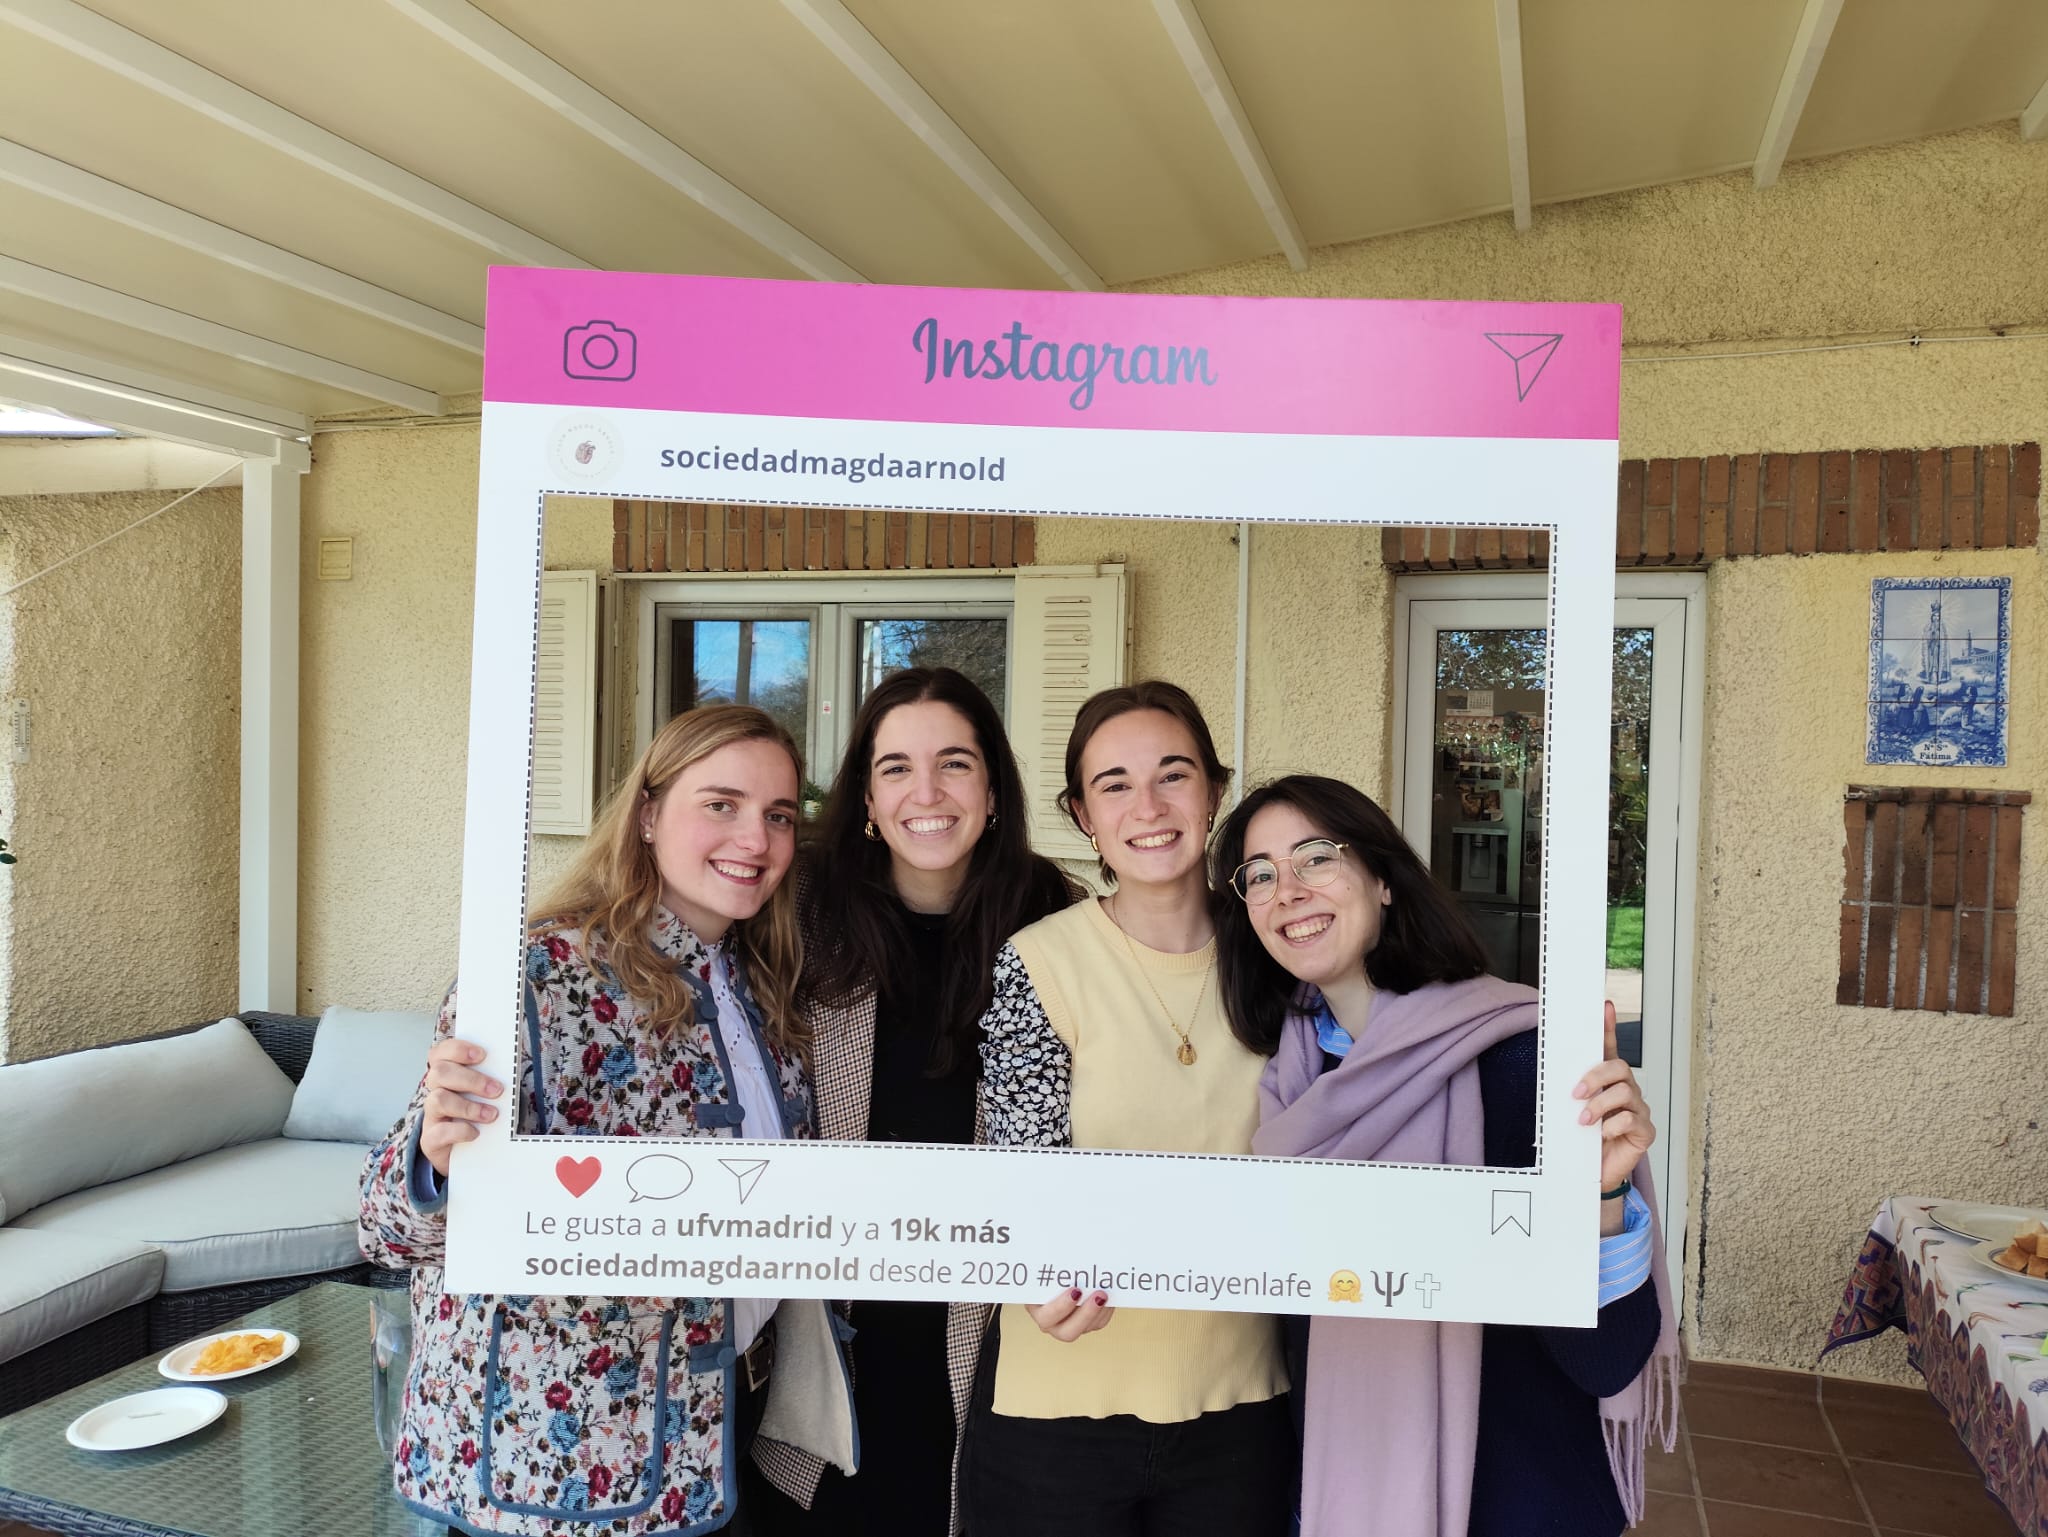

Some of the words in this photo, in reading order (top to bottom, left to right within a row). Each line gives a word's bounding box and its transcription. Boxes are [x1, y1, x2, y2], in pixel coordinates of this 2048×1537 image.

[912, 317, 1218, 410] Instagram
[660, 445, 1006, 483] sociedadmagdaarnold
[525, 1211, 557, 1235] Le
[564, 1214, 642, 1242] gusta
[651, 1218, 666, 1237] a
[677, 1212, 833, 1240] ufvmadrid
[840, 1221, 857, 1247] y
[864, 1222, 879, 1241] a
[890, 1217, 941, 1243] 19k
[949, 1218, 1011, 1245] más
[525, 1252, 860, 1286] sociedadmagdaarnold
[869, 1257, 952, 1284] desde
[960, 1260, 1028, 1287] 2020
[1036, 1263, 1312, 1301] #enlacienciayenlafe
